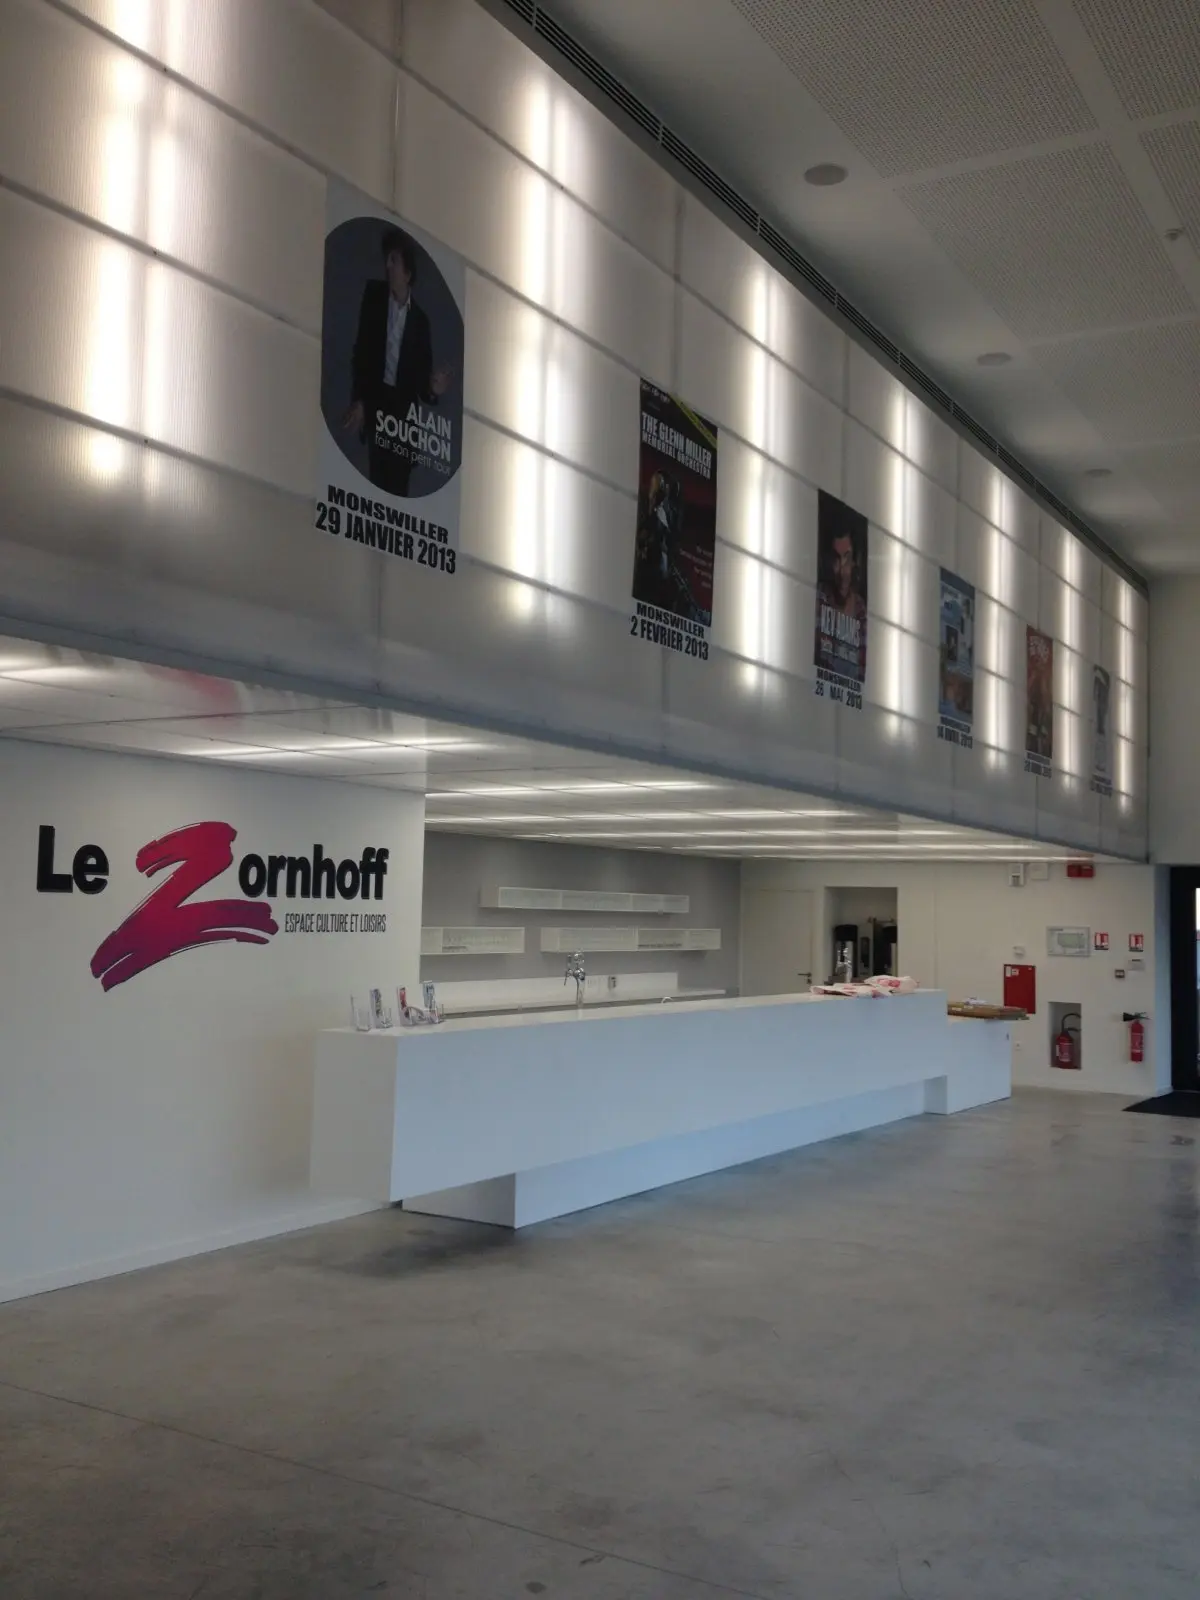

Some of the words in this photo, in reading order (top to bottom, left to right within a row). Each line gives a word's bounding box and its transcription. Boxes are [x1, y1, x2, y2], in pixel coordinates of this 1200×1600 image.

[375, 410, 451, 462] SOUCHON
[406, 402, 452, 440] ALAIN
[642, 411, 658, 437] THE
[660, 422, 685, 452] GLENN
[685, 437, 712, 469] MILLER
[393, 443, 409, 458] son
[411, 449, 431, 468] petit
[641, 431, 676, 459] MEMORIAL
[327, 485, 449, 544] MONSWILLER
[315, 502, 341, 535] 29
[345, 511, 414, 560] JANVIER
[417, 538, 456, 574] 2013
[630, 615, 638, 636] 2
[640, 618, 683, 653] FEVRIER
[684, 635, 709, 661] 2013
[636, 602, 705, 639] MONSWILLER
[37, 825, 110, 894] Le
[284, 912, 315, 933] ESPACE
[316, 912, 349, 933] CULTURE
[350, 912, 359, 933] ET
[360, 912, 387, 933] LOISIRS
